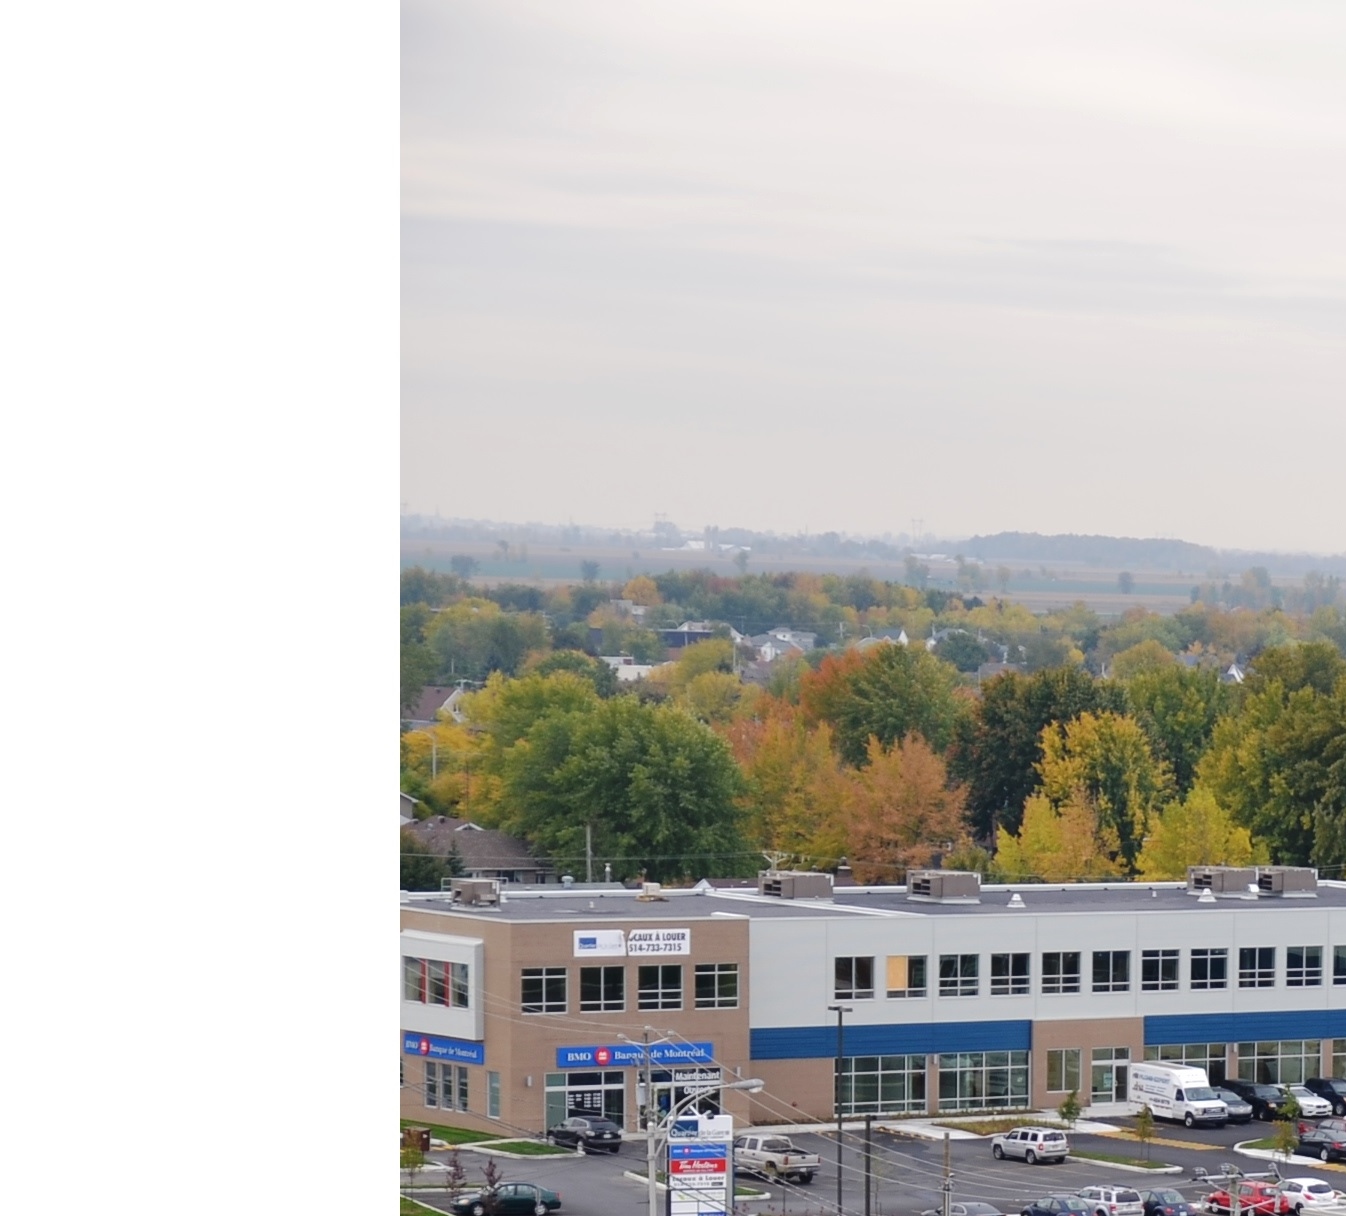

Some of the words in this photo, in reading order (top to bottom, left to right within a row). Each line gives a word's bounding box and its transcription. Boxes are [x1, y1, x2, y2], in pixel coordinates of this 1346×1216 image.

[662, 932, 686, 941] LOUER
[628, 943, 682, 953] 514-733-7315
[567, 1053, 592, 1062] BMO
[650, 1049, 663, 1058] de
[663, 1047, 706, 1058] Montréal
[674, 1071, 720, 1082] Maintenant
[678, 1160, 692, 1170] Tim
